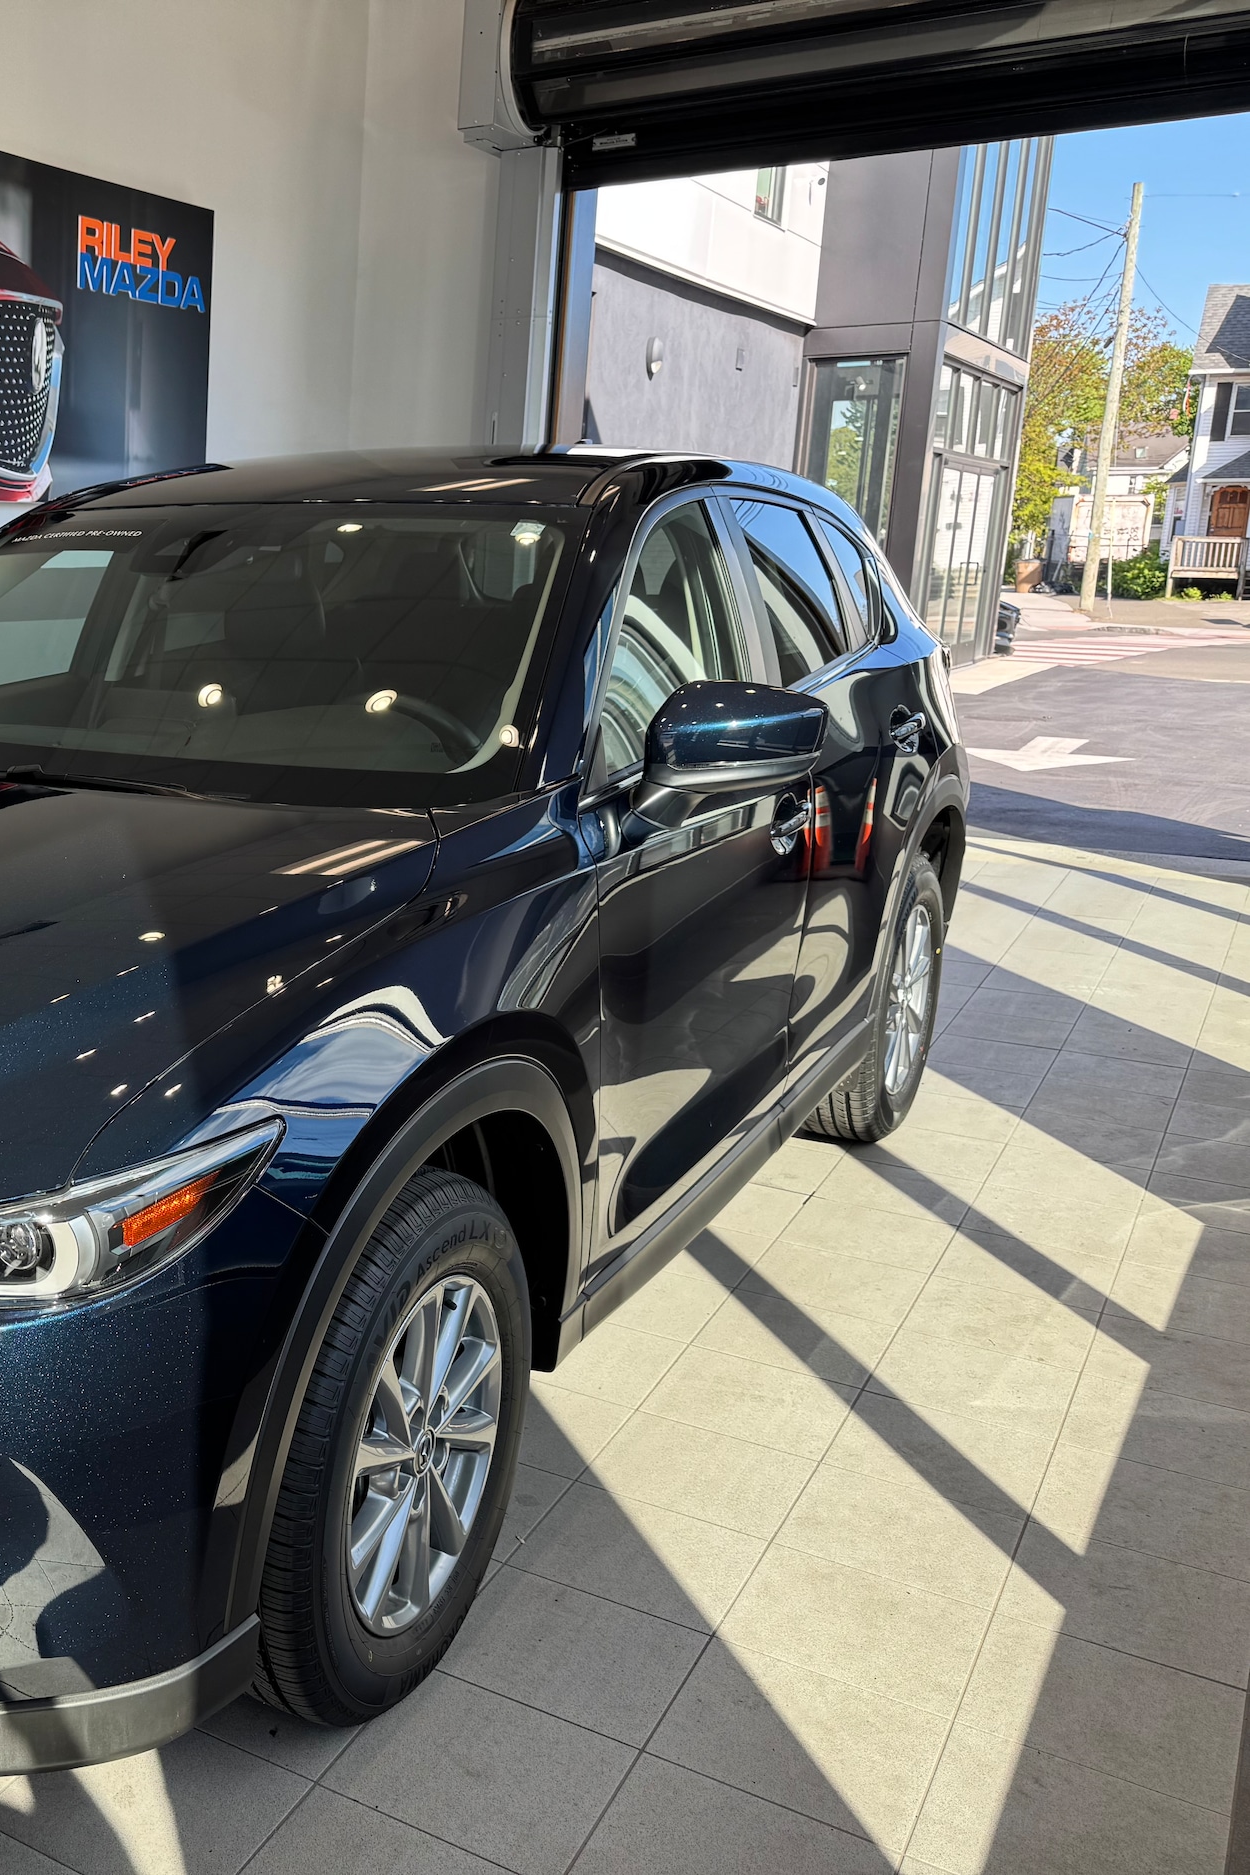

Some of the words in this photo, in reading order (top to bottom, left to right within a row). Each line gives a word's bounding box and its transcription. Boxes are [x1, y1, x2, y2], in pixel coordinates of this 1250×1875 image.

[77, 214, 177, 272] RILEY
[76, 250, 206, 314] MAZDA
[11, 534, 43, 543] MAZDA
[43, 530, 86, 539] CERTIFIED
[415, 1224, 467, 1286] Ascend
[468, 1219, 492, 1241] LX
